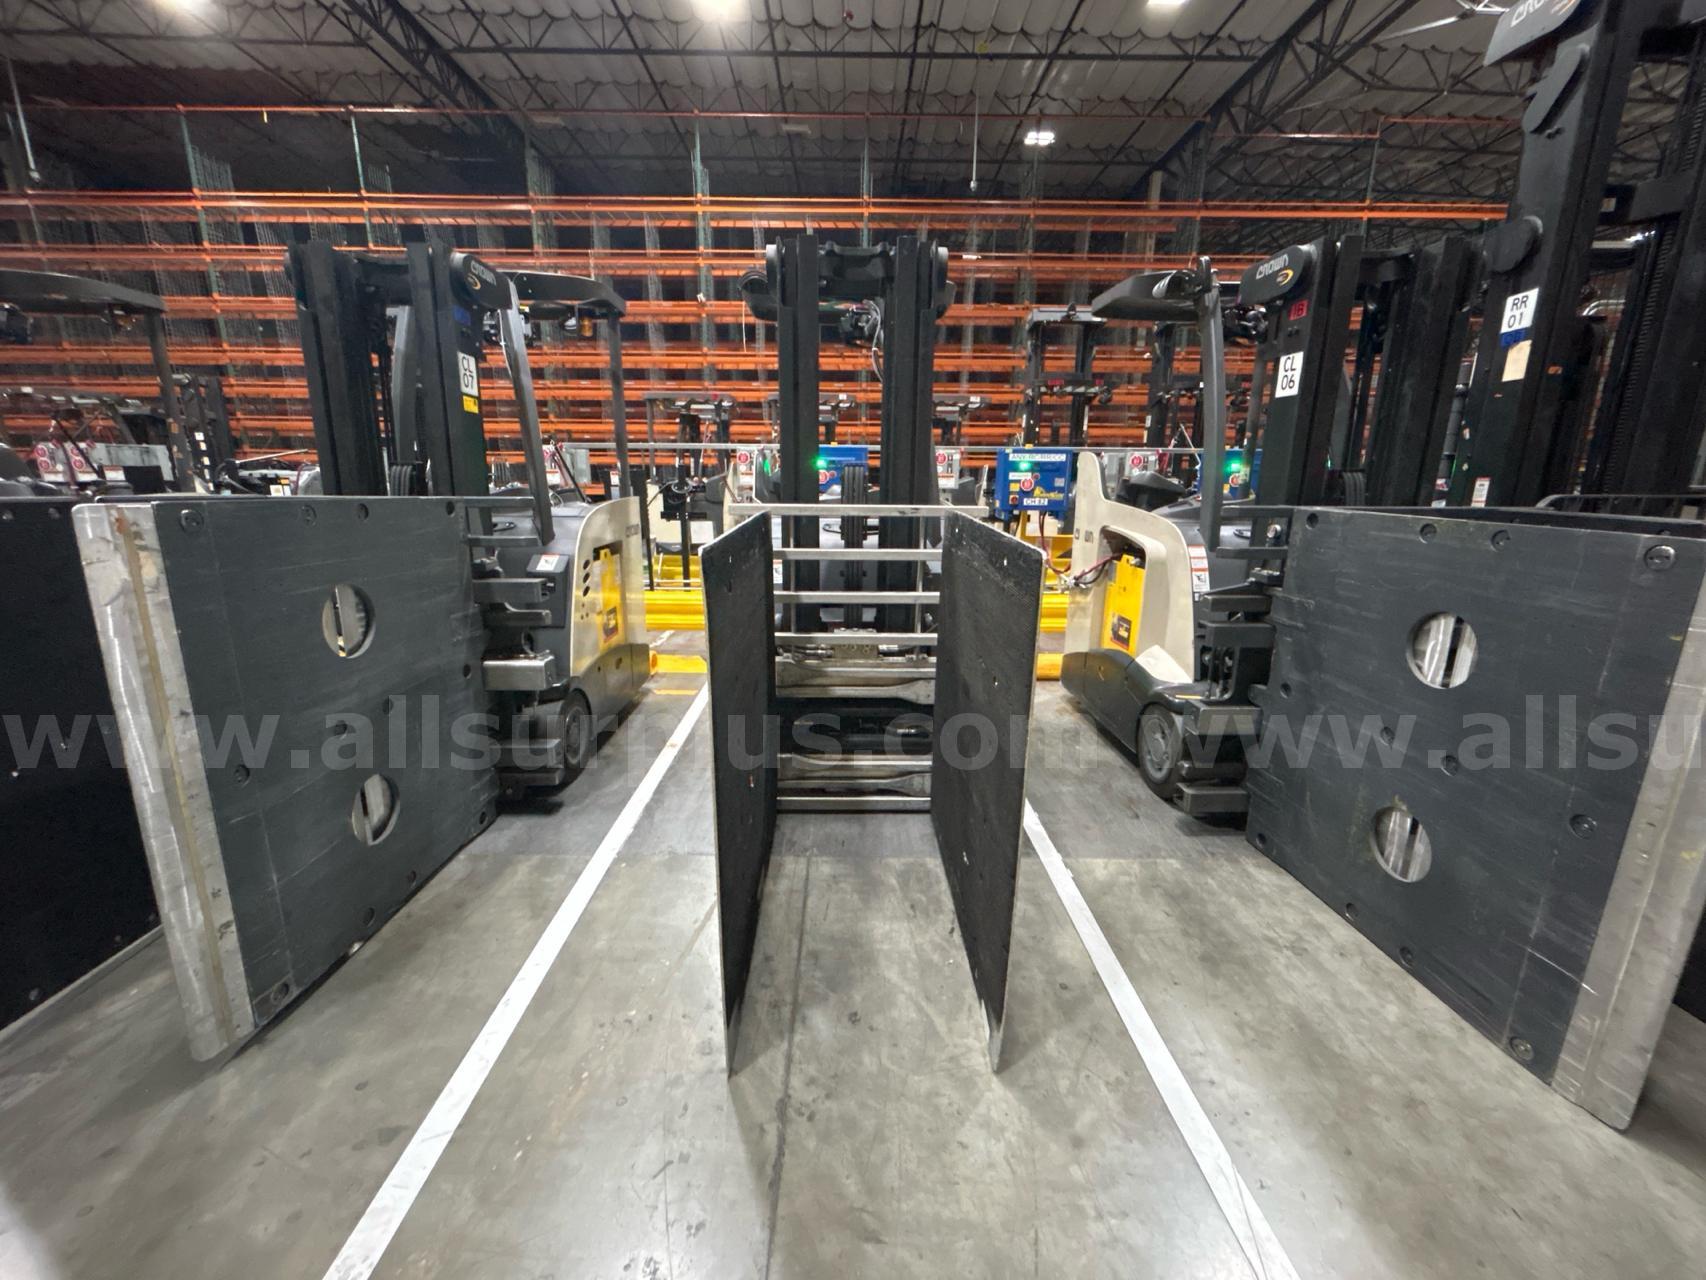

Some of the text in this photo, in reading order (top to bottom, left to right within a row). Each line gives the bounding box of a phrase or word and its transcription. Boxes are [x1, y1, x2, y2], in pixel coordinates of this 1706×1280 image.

[1256, 254, 1289, 279] CROWN
[1510, 295, 1529, 312] RR
[1507, 312, 1524, 329] 01
[461, 356, 474, 374] CL
[1284, 355, 1297, 372] CL
[463, 373, 475, 390] 07
[1281, 374, 1296, 390] 06
